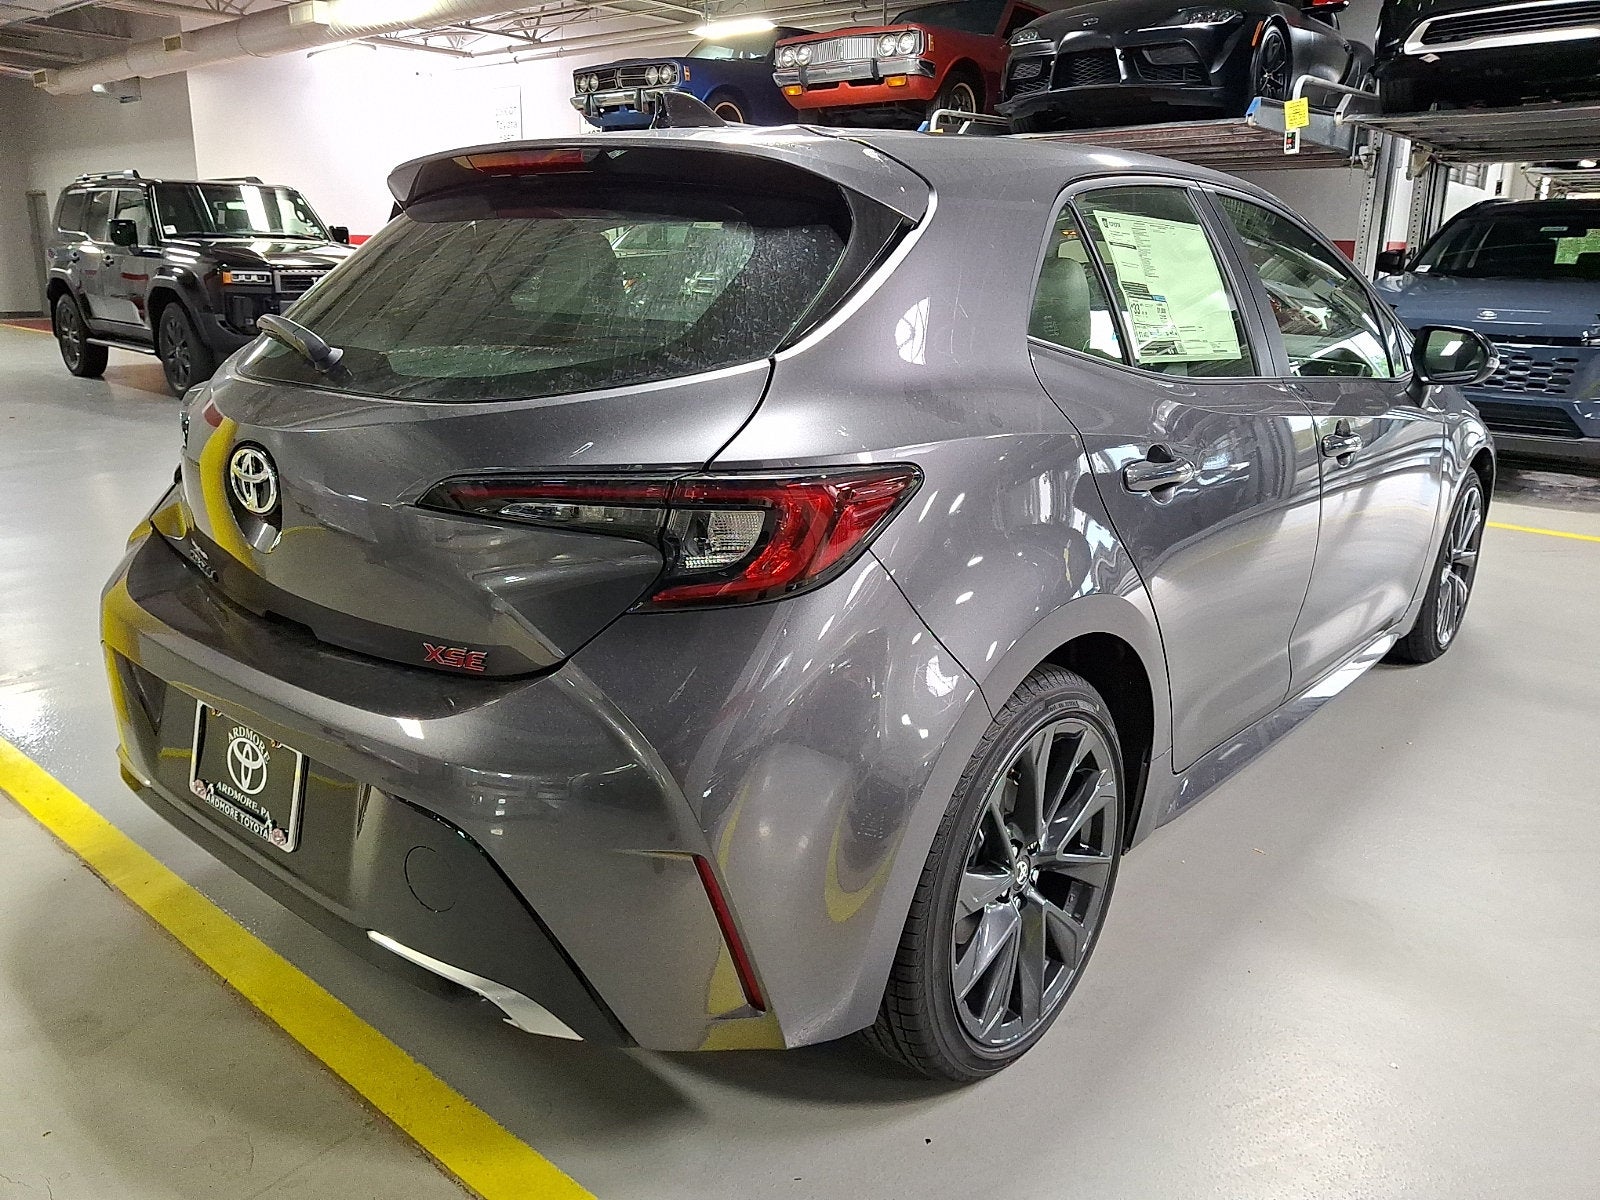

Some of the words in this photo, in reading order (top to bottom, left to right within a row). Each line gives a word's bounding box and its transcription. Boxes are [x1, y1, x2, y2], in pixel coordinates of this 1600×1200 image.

[422, 642, 488, 672] XSE
[228, 726, 271, 764] ARDMORE
[205, 793, 239, 820] ARDMORE
[240, 814, 269, 841] TOYOTA
